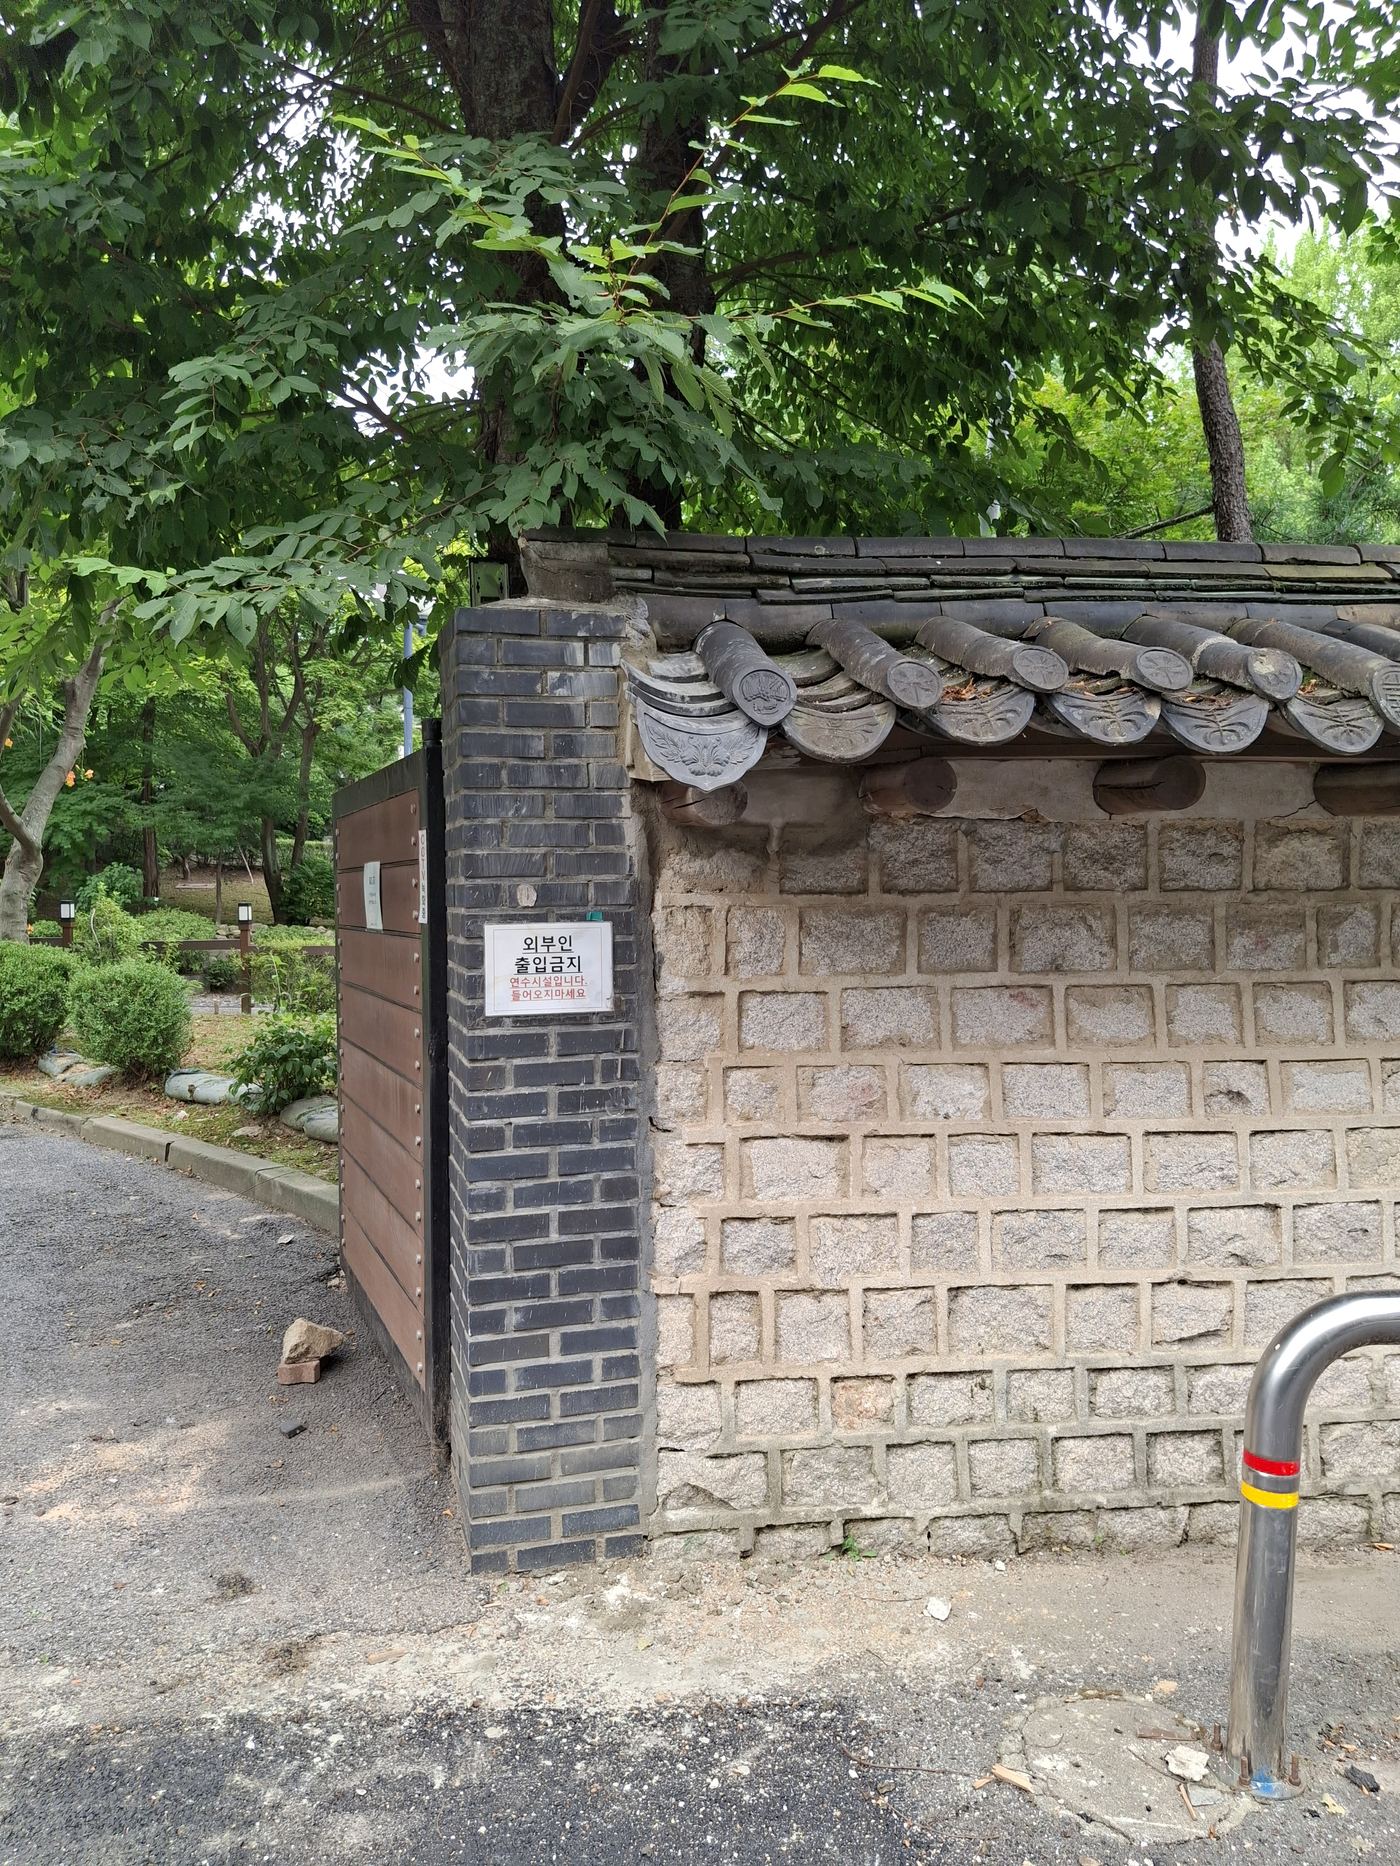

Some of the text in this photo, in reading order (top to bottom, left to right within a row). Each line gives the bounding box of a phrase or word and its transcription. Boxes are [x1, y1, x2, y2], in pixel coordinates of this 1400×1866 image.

[522, 935, 574, 954] 외부인
[514, 955, 582, 975] 출입금지
[509, 975, 588, 988] 연수시설입니다.
[511, 988, 586, 1002] 들어오지마세요
